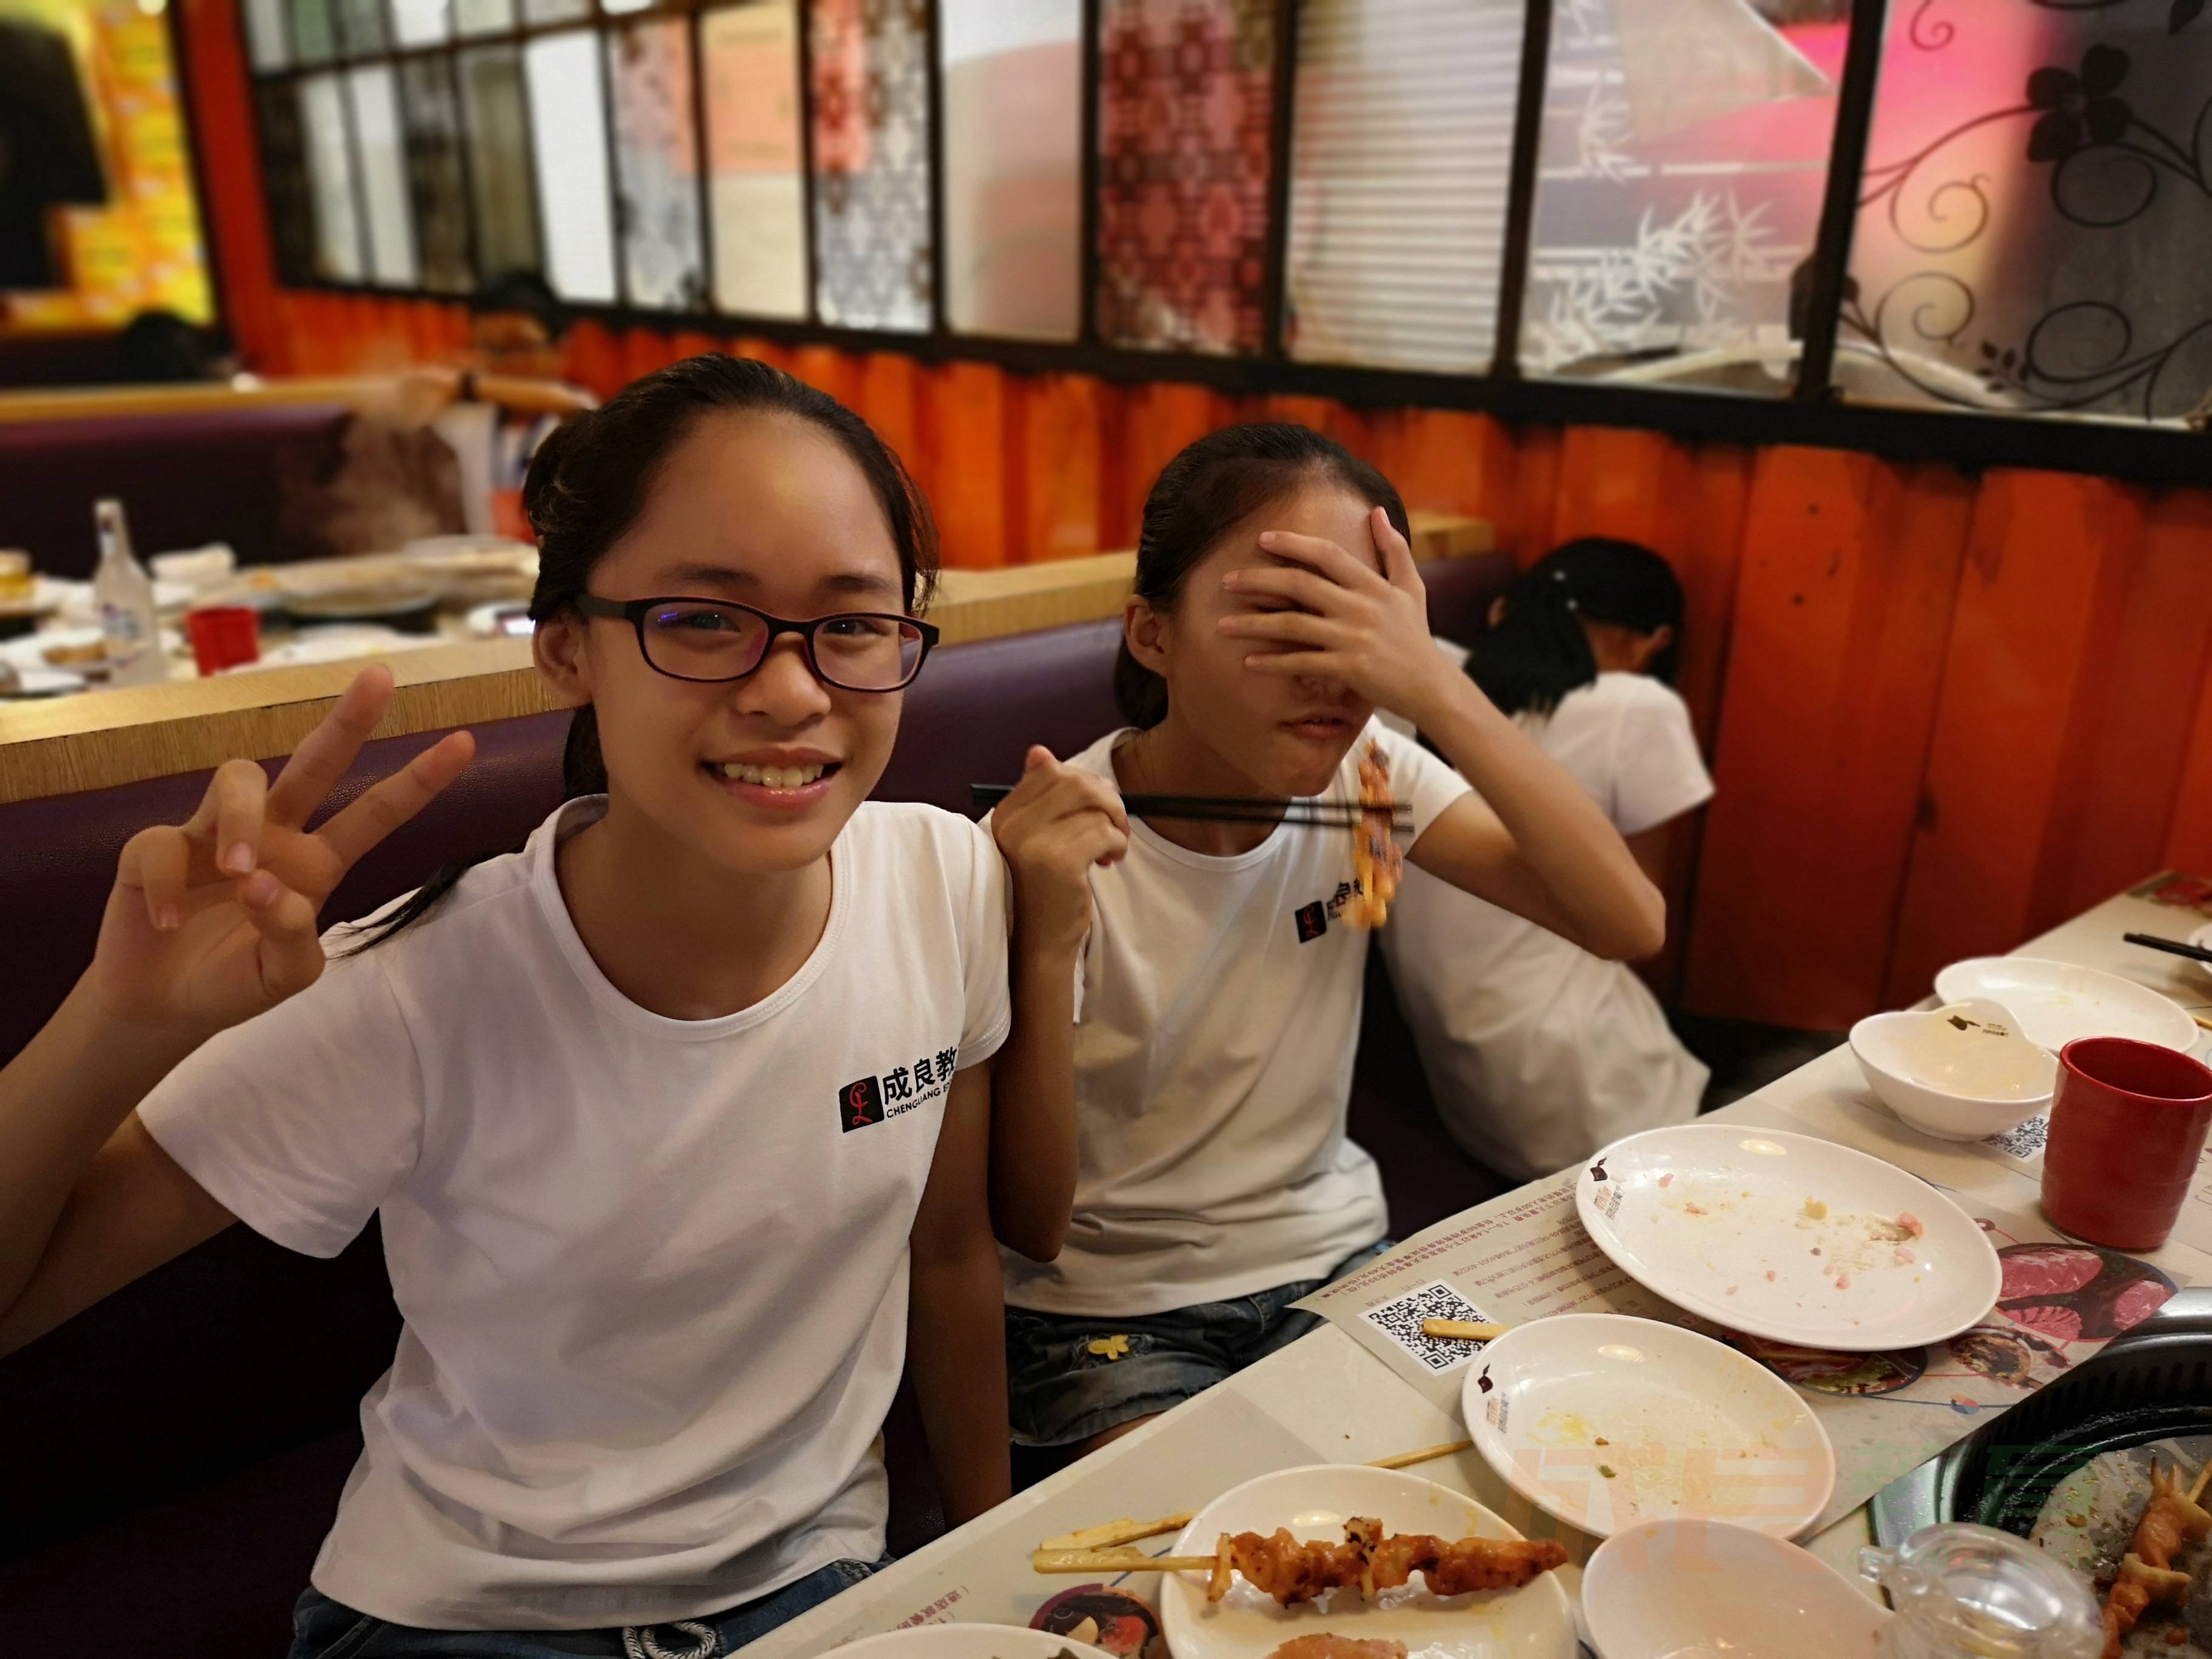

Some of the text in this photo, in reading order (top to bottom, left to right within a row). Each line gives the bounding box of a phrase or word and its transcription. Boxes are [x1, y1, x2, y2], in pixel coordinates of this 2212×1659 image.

[882, 1046, 957, 1105] 成良教
[886, 1087, 941, 1118] CHENGLIANG
[886, 1585, 969, 1632] （进店就餐的
